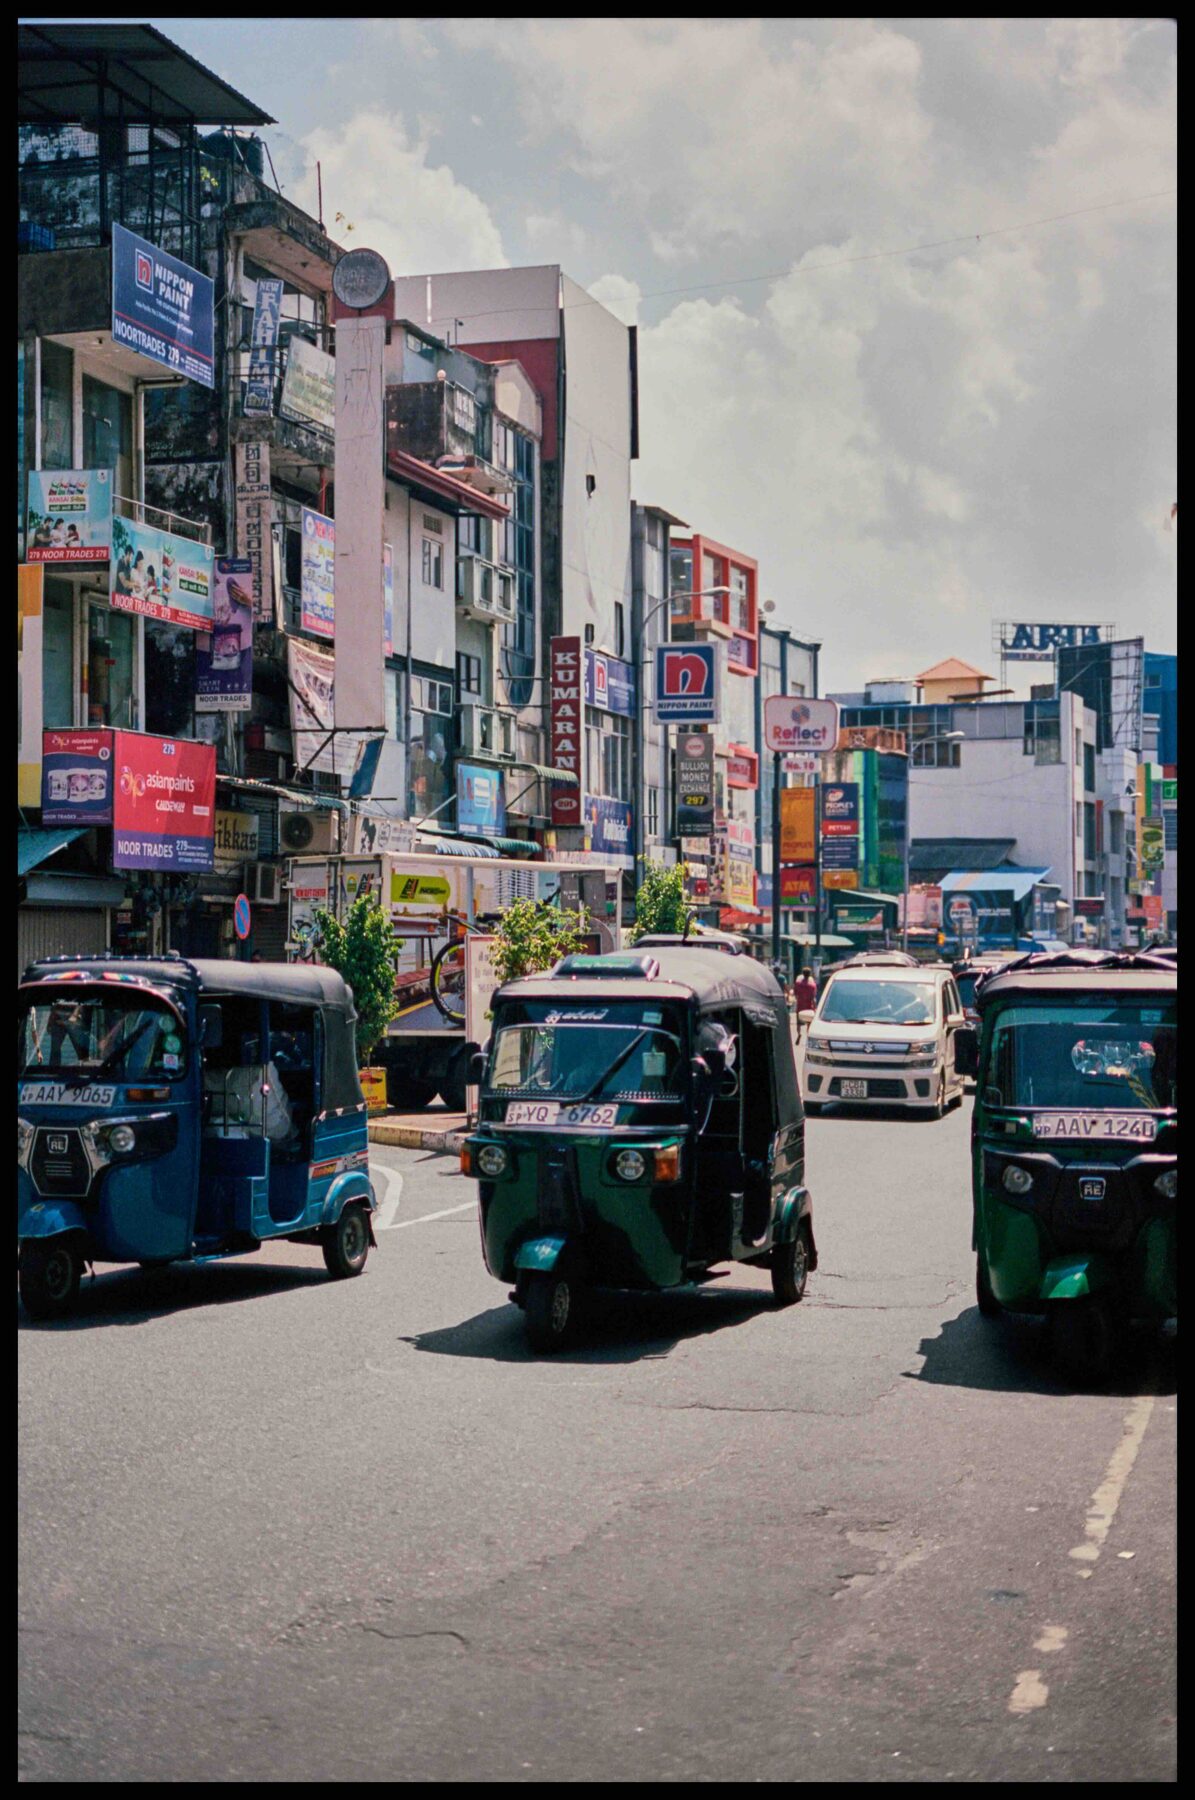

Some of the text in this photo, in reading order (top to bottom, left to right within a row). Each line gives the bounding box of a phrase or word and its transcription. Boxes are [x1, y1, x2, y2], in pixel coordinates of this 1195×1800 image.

[155, 263, 194, 297] NIPPON
[260, 281, 279, 291] NEW
[159, 281, 190, 310] PAINT
[168, 345, 180, 364] 279
[42, 551, 64, 559] NOOR
[66, 550, 94, 558] TRADES
[115, 594, 171, 619] NOOR TRADES 279
[689, 701, 713, 709] PAINT
[773, 725, 827, 740] Reflect
[163, 743, 175, 755] 279
[680, 762, 709, 771] BULLION
[146, 770, 195, 798] asianpaints
[681, 773, 710, 782] MONEY
[680, 783, 710, 793] EXCHANGE
[686, 796, 704, 806] 297
[118, 840, 141, 856] NOOR
[142, 842, 173, 858] TRADES
[176, 840, 188, 851] 279
[784, 881, 810, 892] ATM
[35, 1086, 66, 1102] AAY
[72, 1086, 113, 1104] 9065
[508, 1112, 521, 1123] SP
[526, 1106, 549, 1122] YQ
[568, 1106, 613, 1124] 6762
[1055, 1118, 1093, 1135] AAV
[1103, 1118, 1154, 1137] 1240
